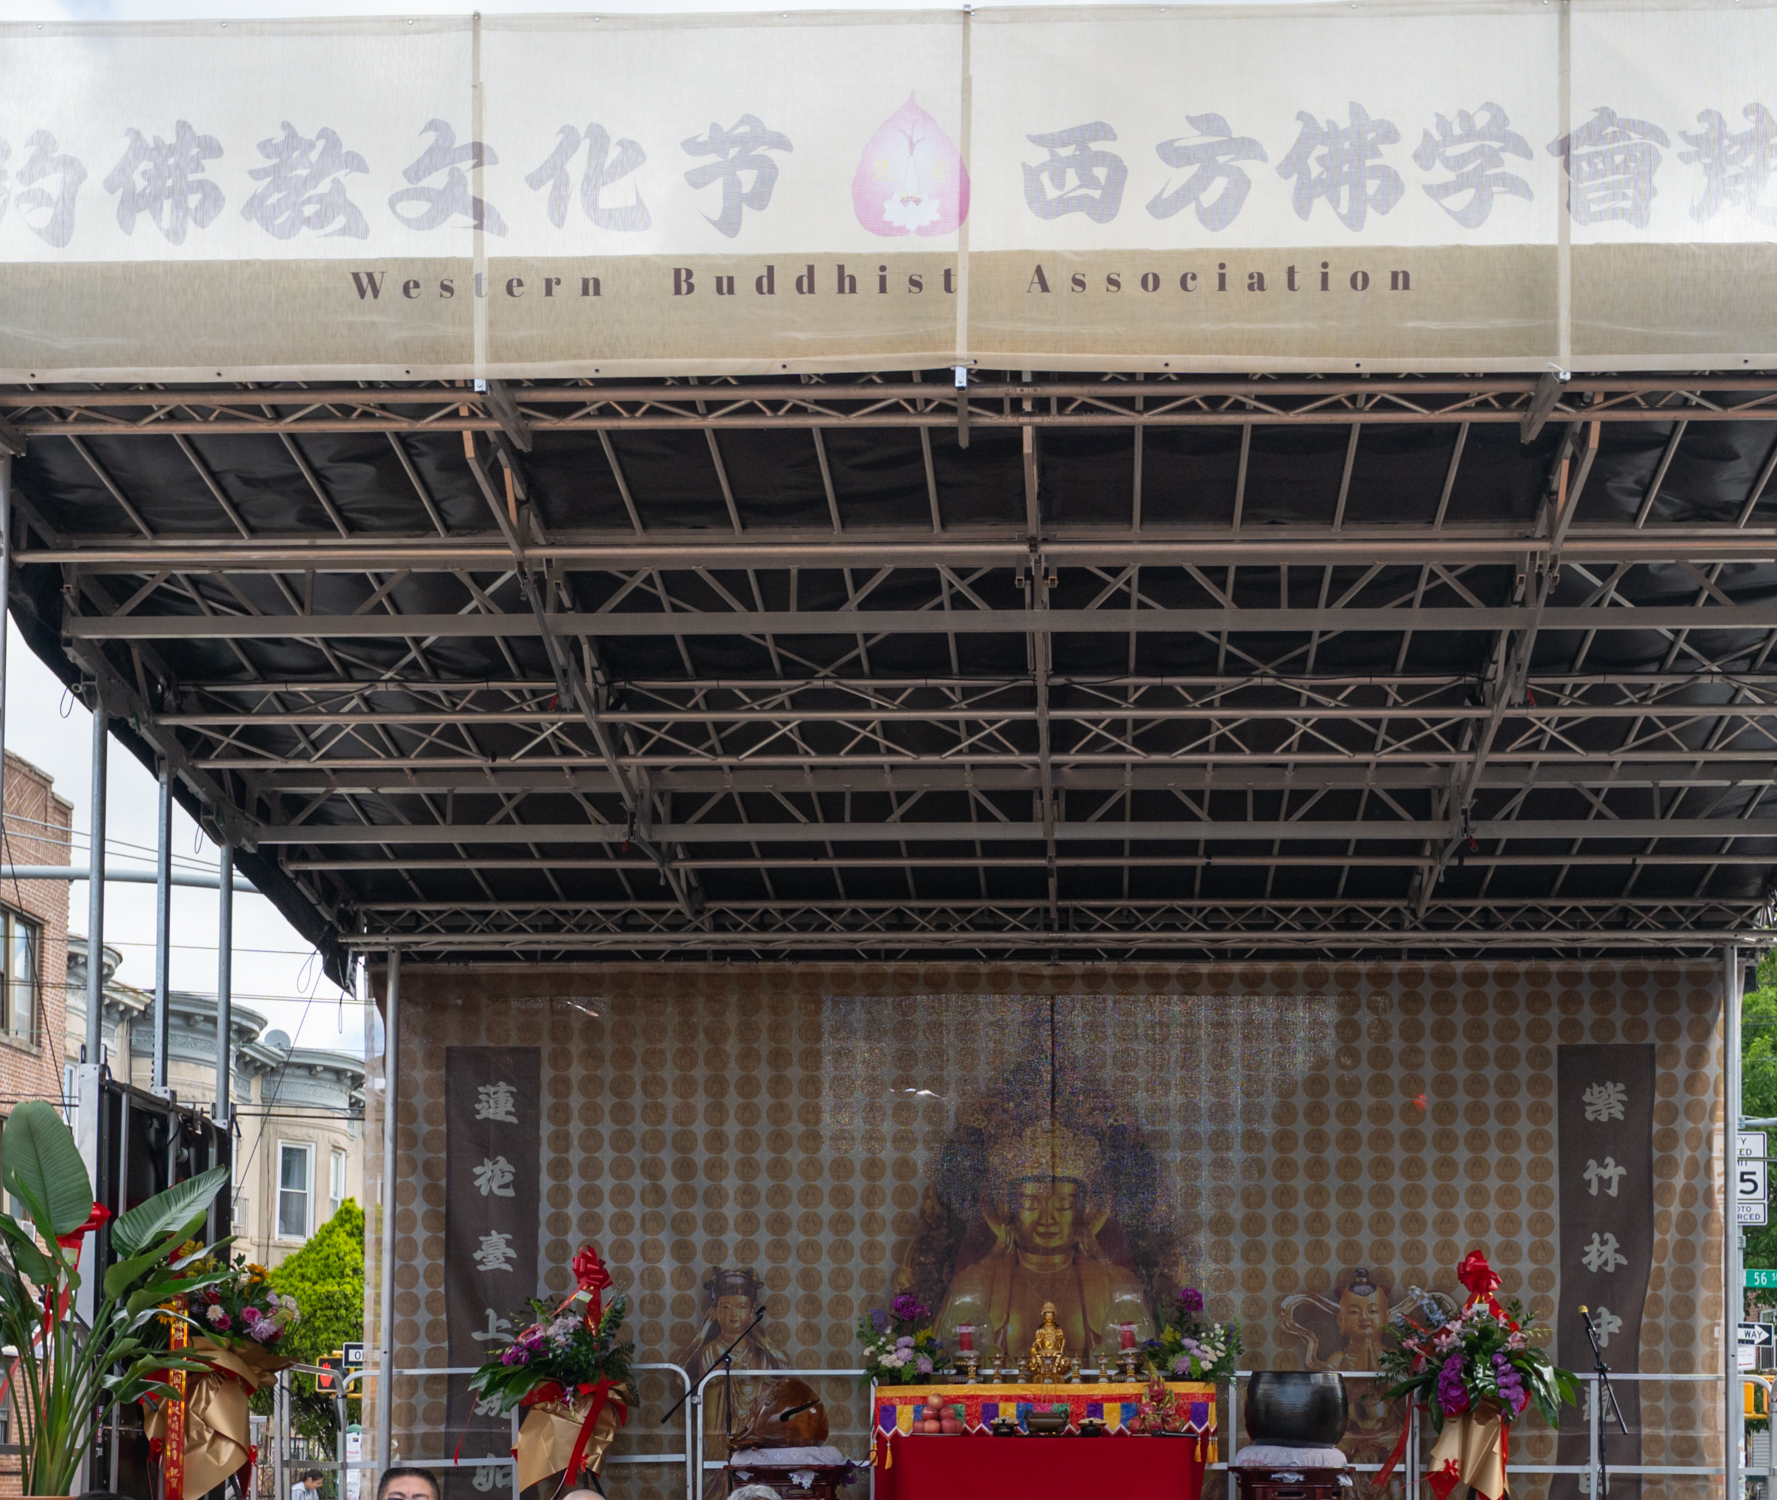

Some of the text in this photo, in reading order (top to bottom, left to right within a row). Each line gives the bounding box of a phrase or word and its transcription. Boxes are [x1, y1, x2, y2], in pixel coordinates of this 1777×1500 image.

[349, 260, 1413, 300] Western Buddhist Association
[1754, 1271, 1768, 1286] 56
[1744, 1329, 1763, 1339] WAY
